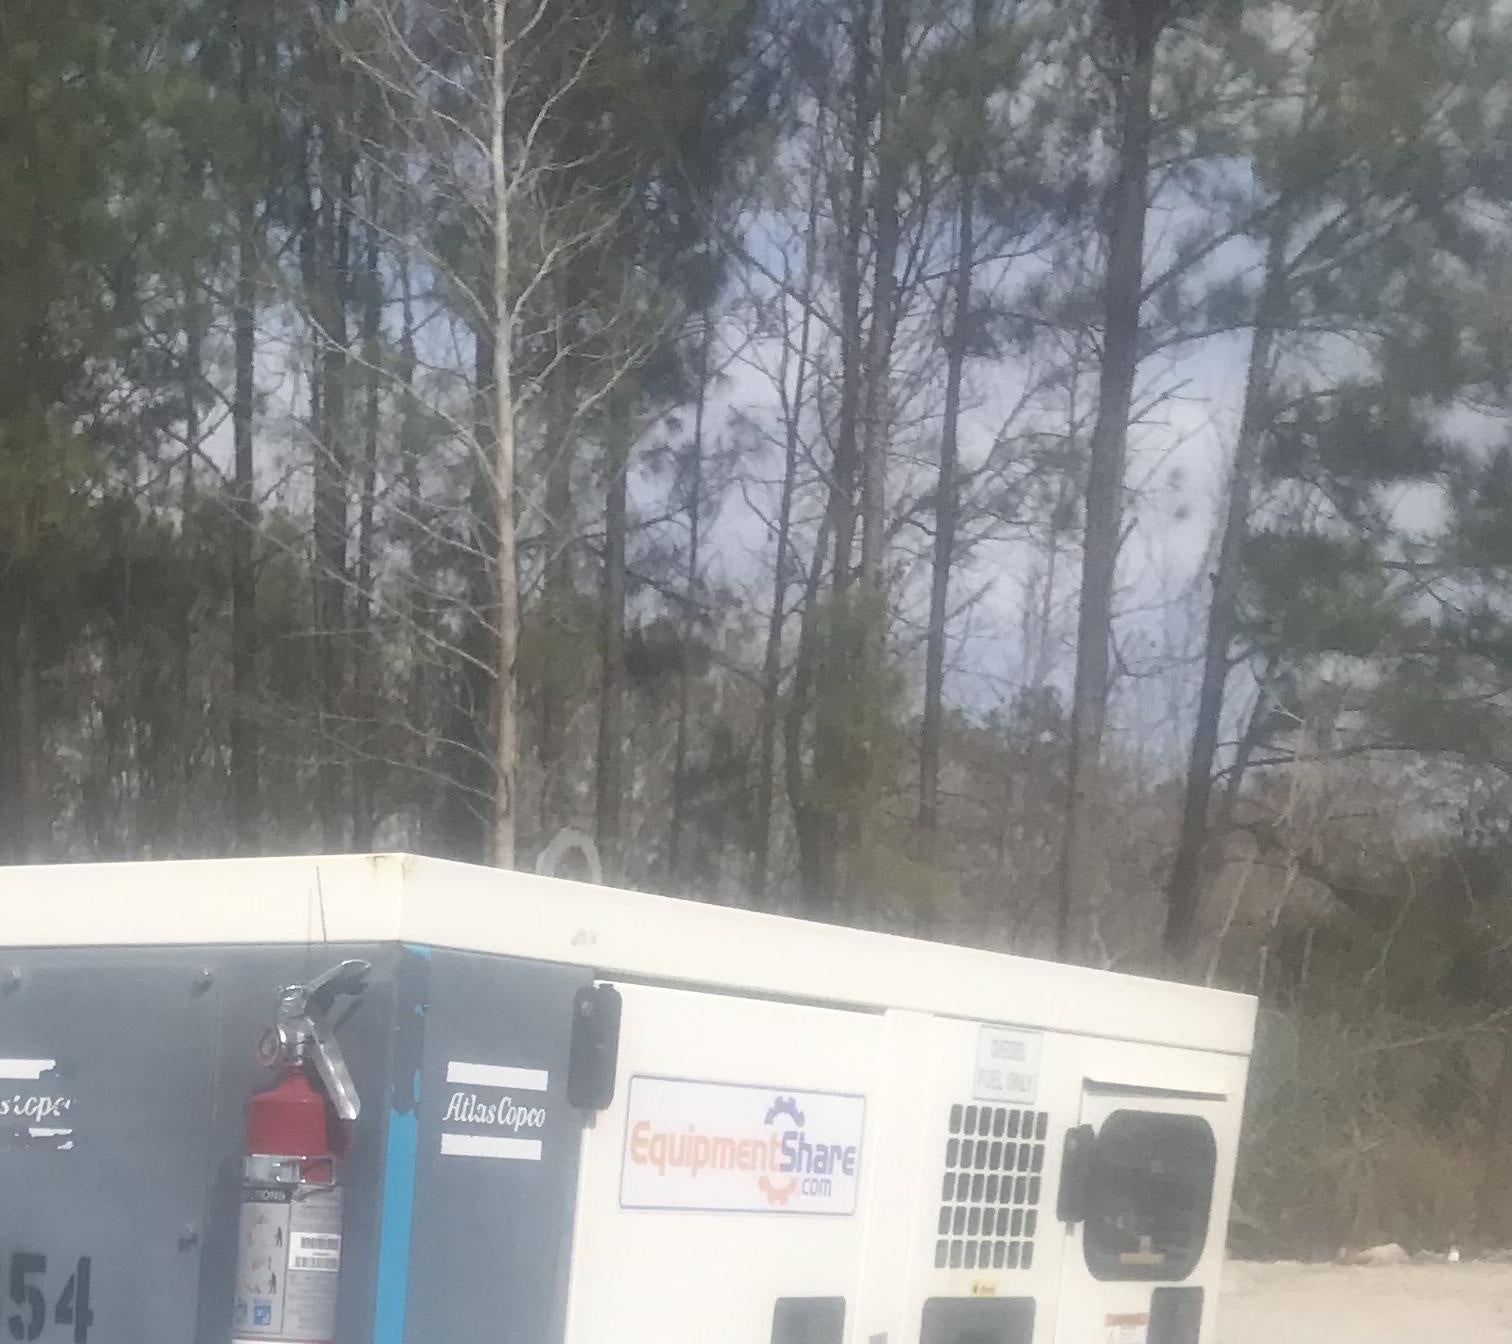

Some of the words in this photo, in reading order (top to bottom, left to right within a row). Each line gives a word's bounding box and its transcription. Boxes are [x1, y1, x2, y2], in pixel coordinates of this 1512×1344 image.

[442, 1092, 497, 1124] Atlas
[497, 1096, 546, 1133] Copco
[630, 1120, 857, 1177] EquipmentShare
